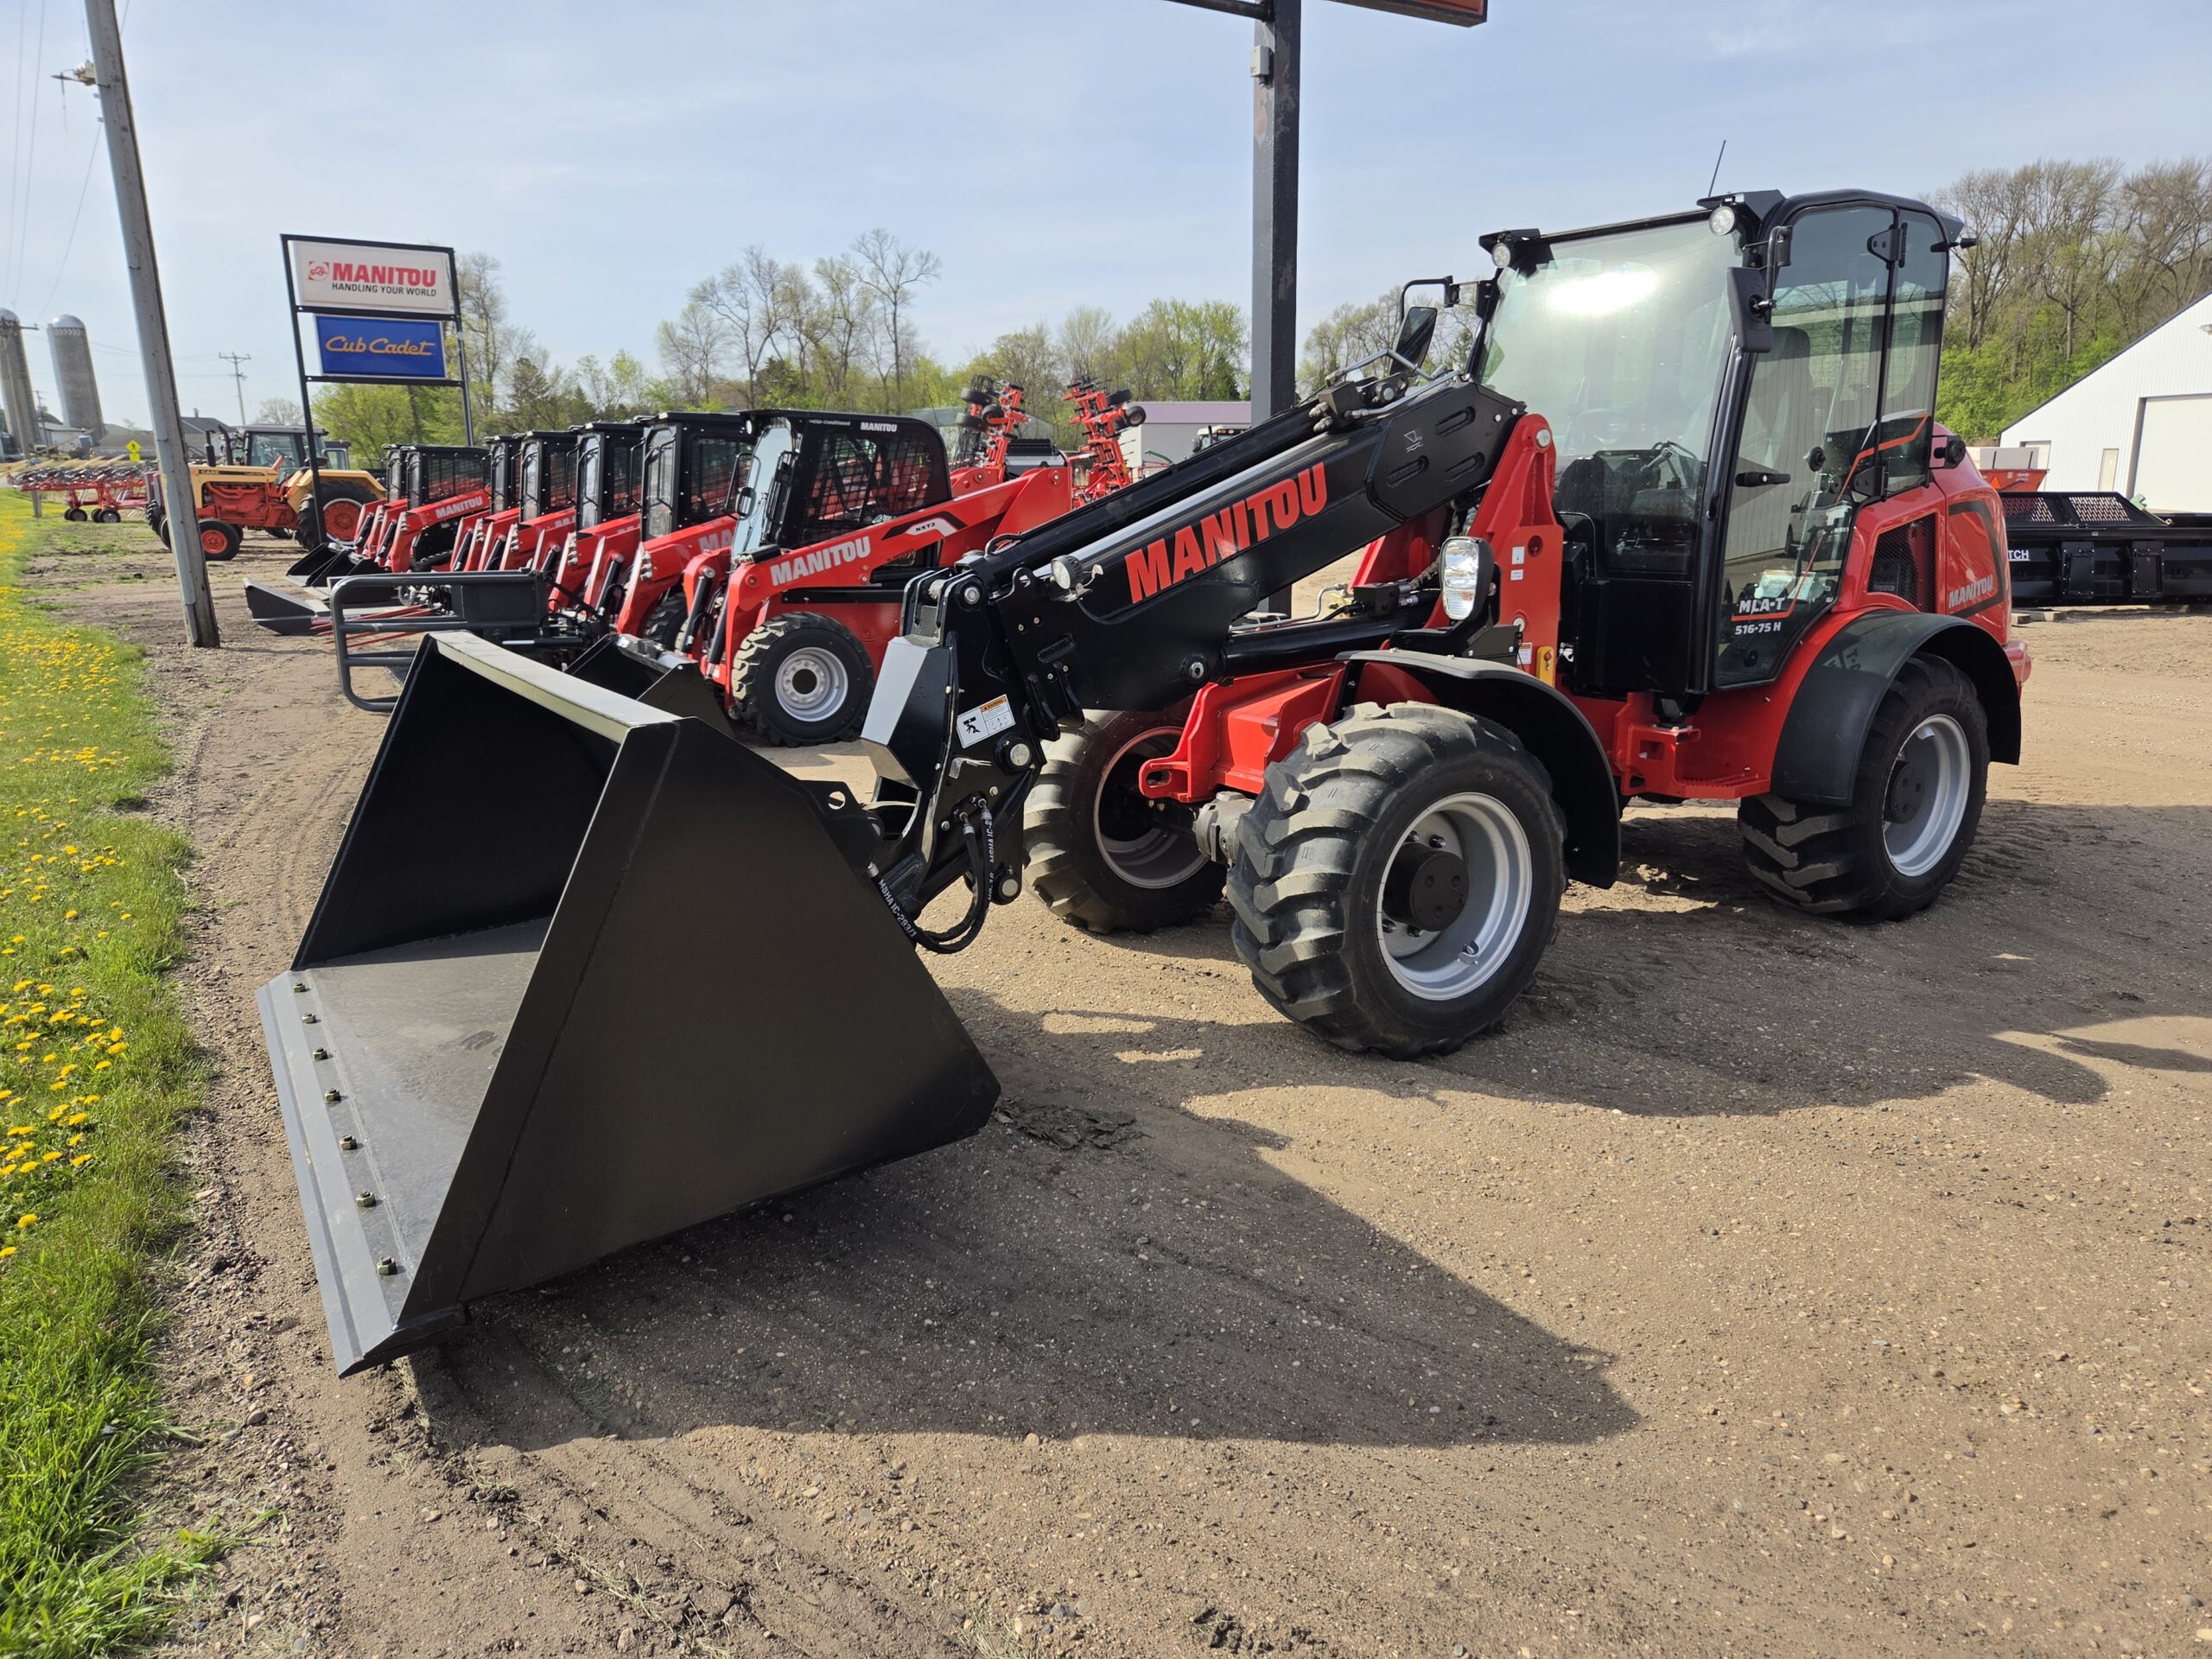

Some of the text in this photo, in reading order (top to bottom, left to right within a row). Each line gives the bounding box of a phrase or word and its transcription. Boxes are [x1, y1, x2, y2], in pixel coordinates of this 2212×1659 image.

[333, 263, 436, 288] MANITOU
[332, 283, 436, 296] HANDLING YOUR WORLD
[326, 336, 435, 356] Cub Cadet
[861, 422, 898, 432] MANITOU
[435, 496, 483, 518] MANITOU
[916, 522, 936, 532] NXT2
[1125, 461, 1327, 604] MANITOU
[770, 536, 872, 587] MANITOU
[1948, 575, 1994, 608] MANITOU
[1773, 622, 1782, 632] H
